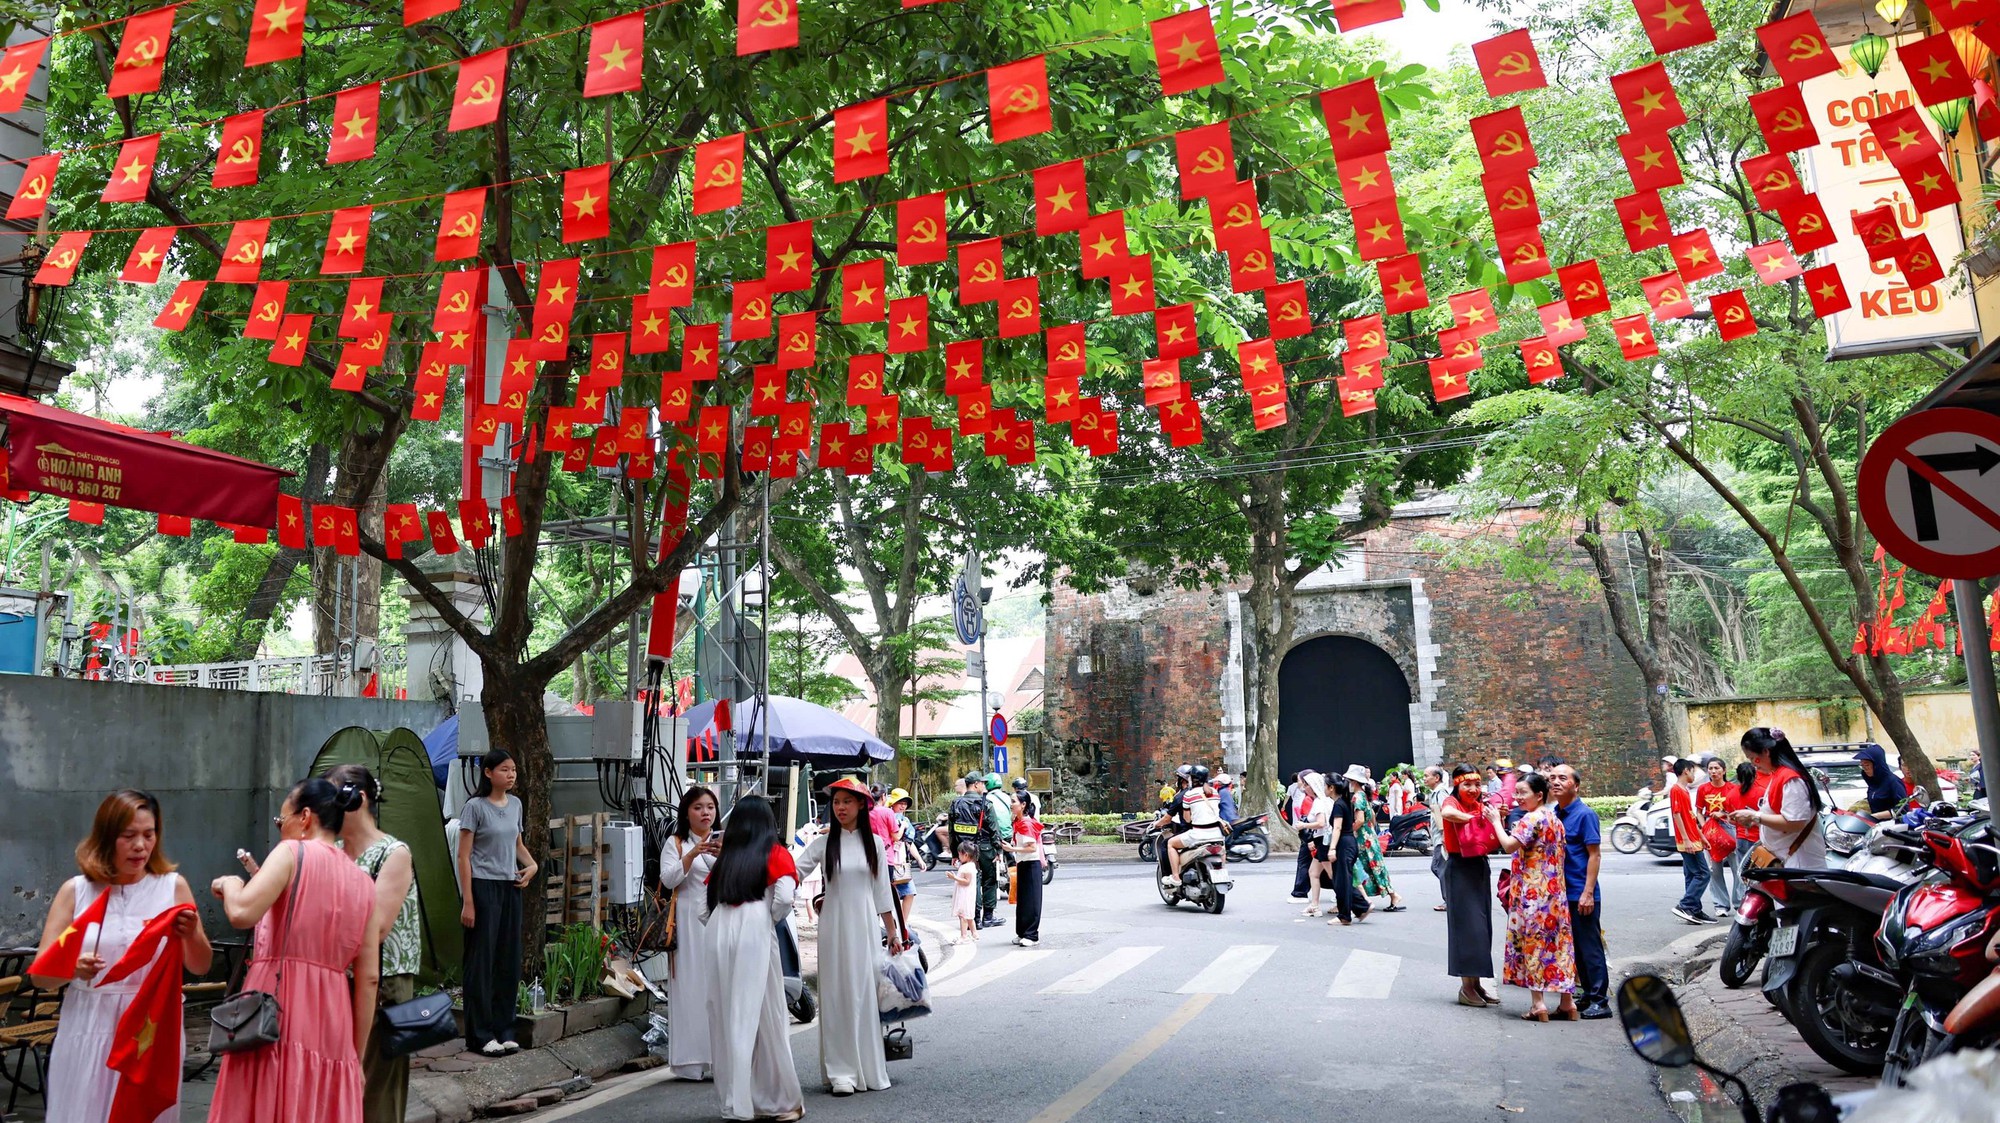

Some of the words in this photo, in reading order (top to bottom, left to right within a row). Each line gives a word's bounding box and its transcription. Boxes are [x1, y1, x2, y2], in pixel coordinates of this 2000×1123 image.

[51, 457, 94, 479] HOÀNG
[97, 465, 122, 483] ANH
[77, 480, 99, 496] 360
[101, 484, 121, 500] 287
